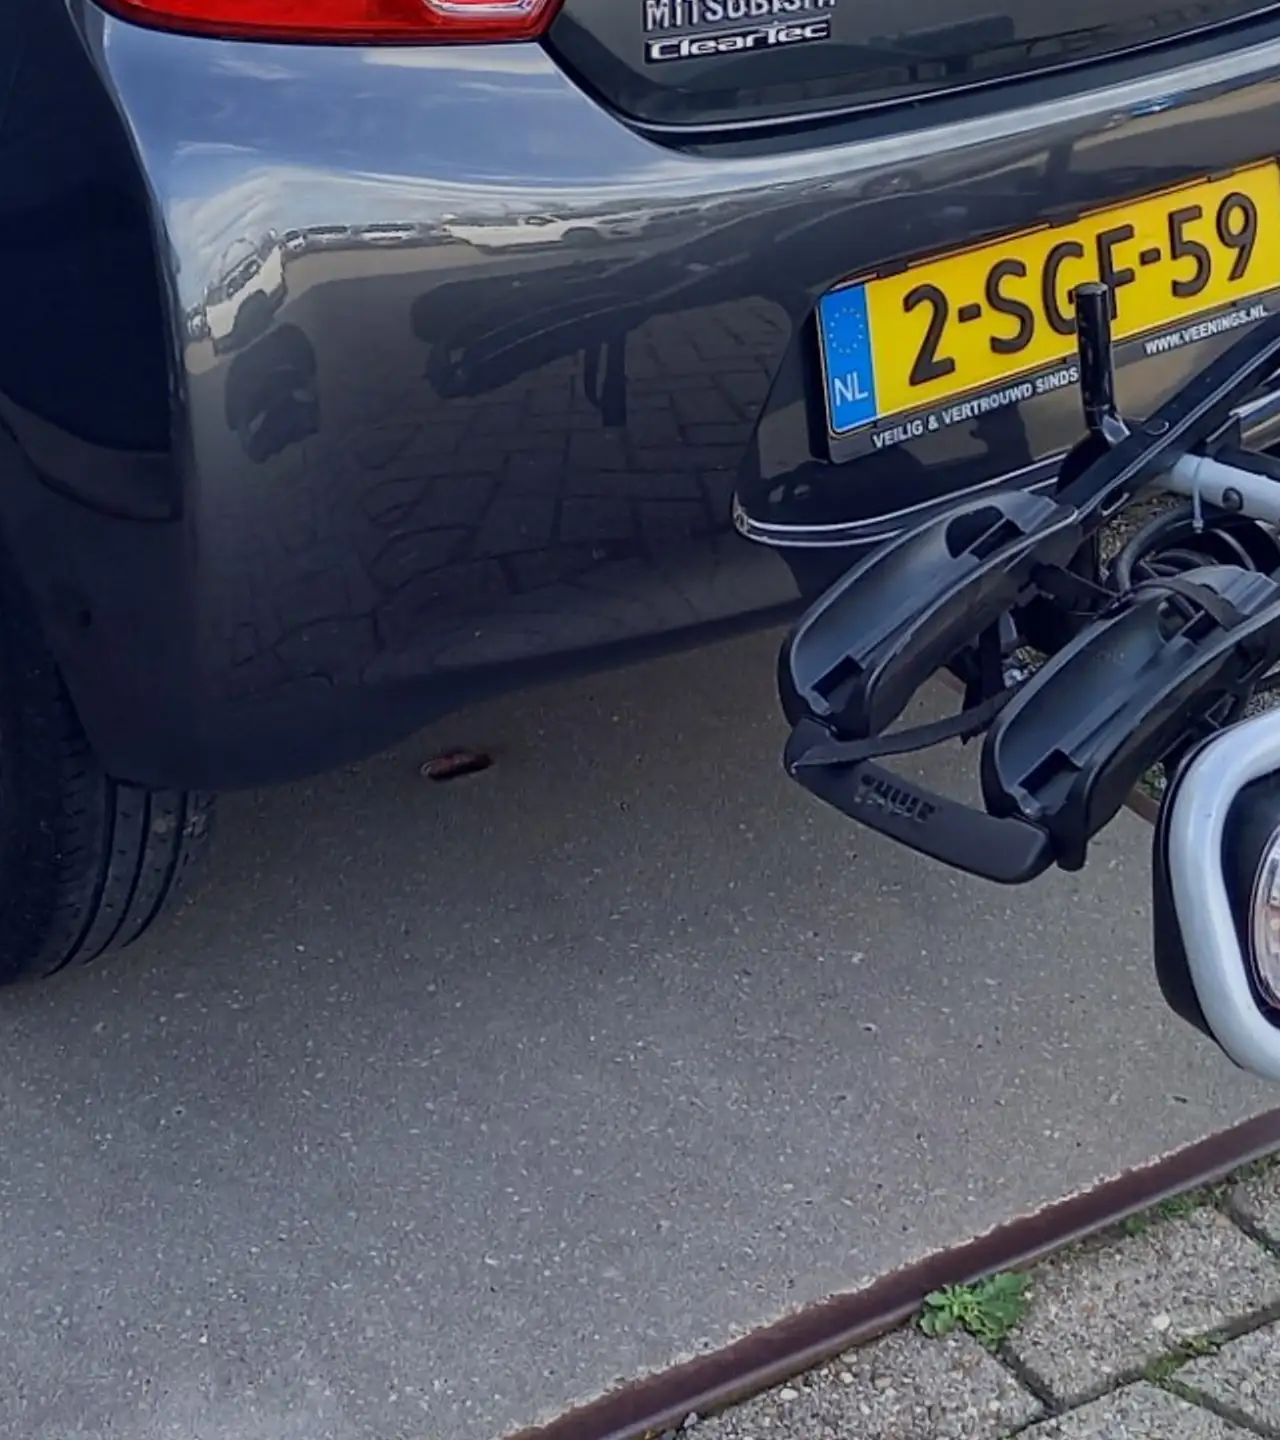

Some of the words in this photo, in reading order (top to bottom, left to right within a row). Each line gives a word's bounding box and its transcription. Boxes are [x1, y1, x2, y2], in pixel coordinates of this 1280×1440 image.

[902, 191, 1258, 388] 2-SGF-59
[1143, 304, 1269, 356] WWW.VEENINGS.NL
[833, 372, 869, 407] NL
[872, 420, 924, 449] VEILIG
[928, 413, 939, 431] &
[941, 380, 1033, 424] VERTROUWD
[1035, 366, 1080, 394] SINDS
